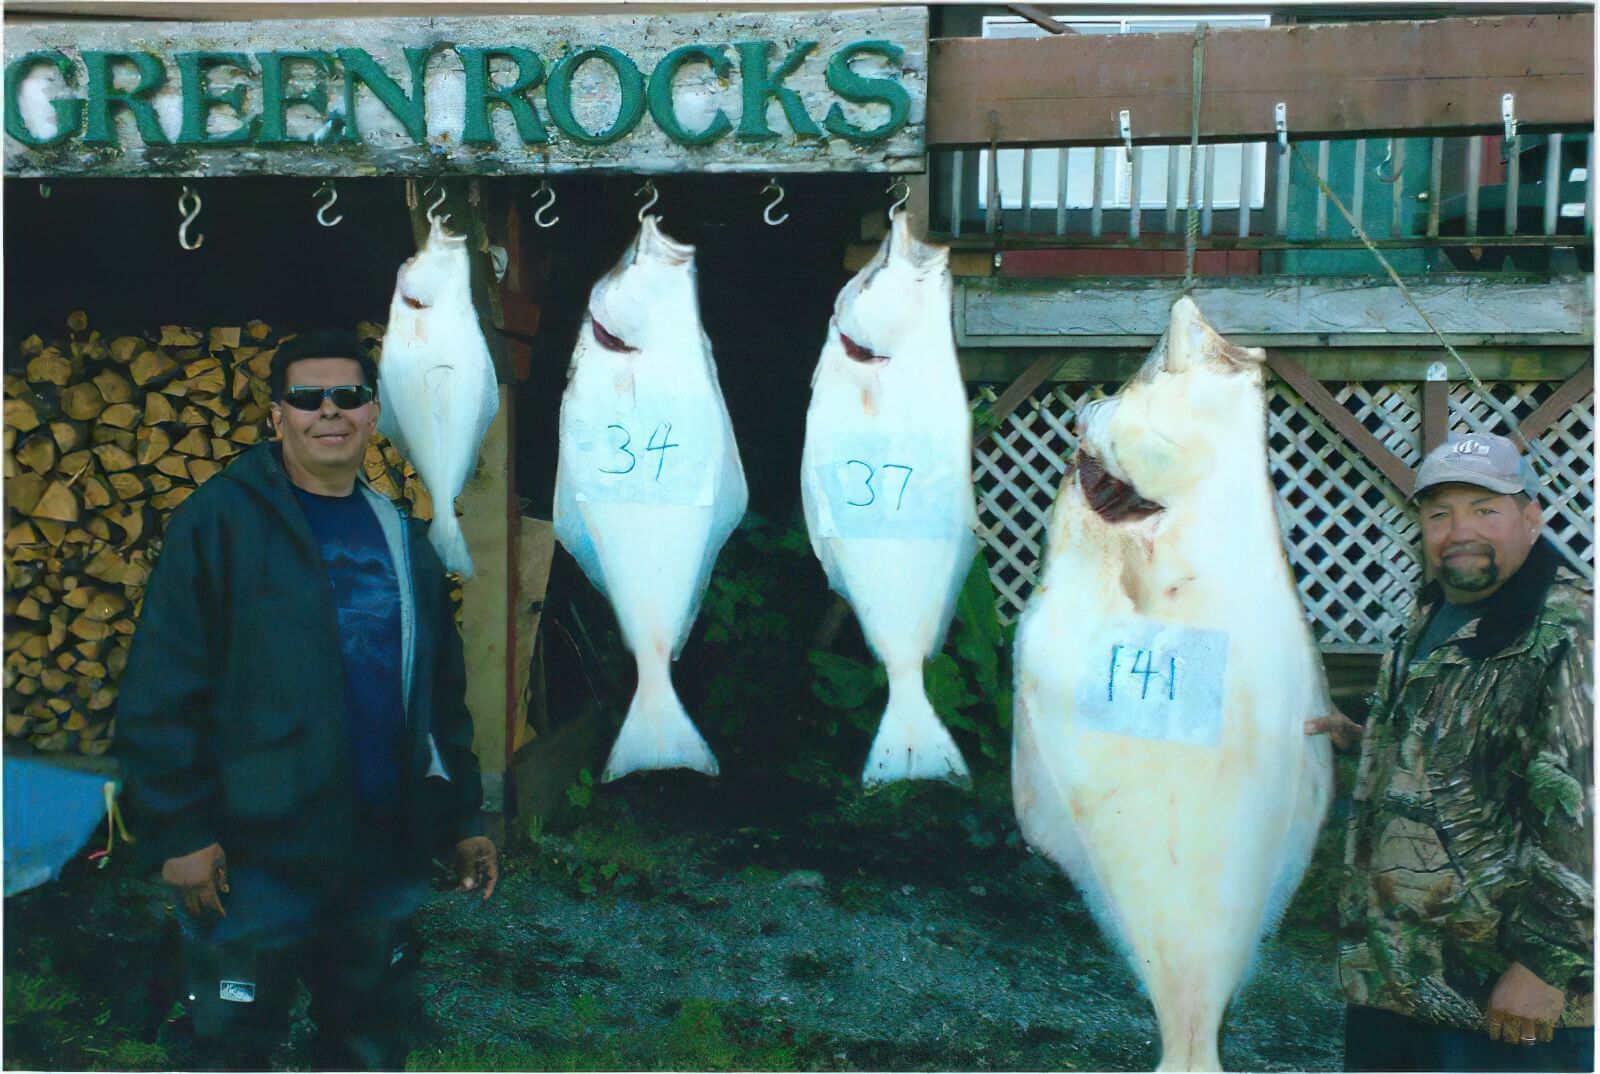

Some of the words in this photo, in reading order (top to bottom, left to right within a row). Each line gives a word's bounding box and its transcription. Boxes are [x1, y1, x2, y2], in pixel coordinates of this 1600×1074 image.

[4, 46, 431, 148] GREEN
[457, 40, 911, 145] ROCKS
[599, 422, 679, 482] 34
[846, 459, 913, 512] 37
[1107, 643, 1178, 701] 141
